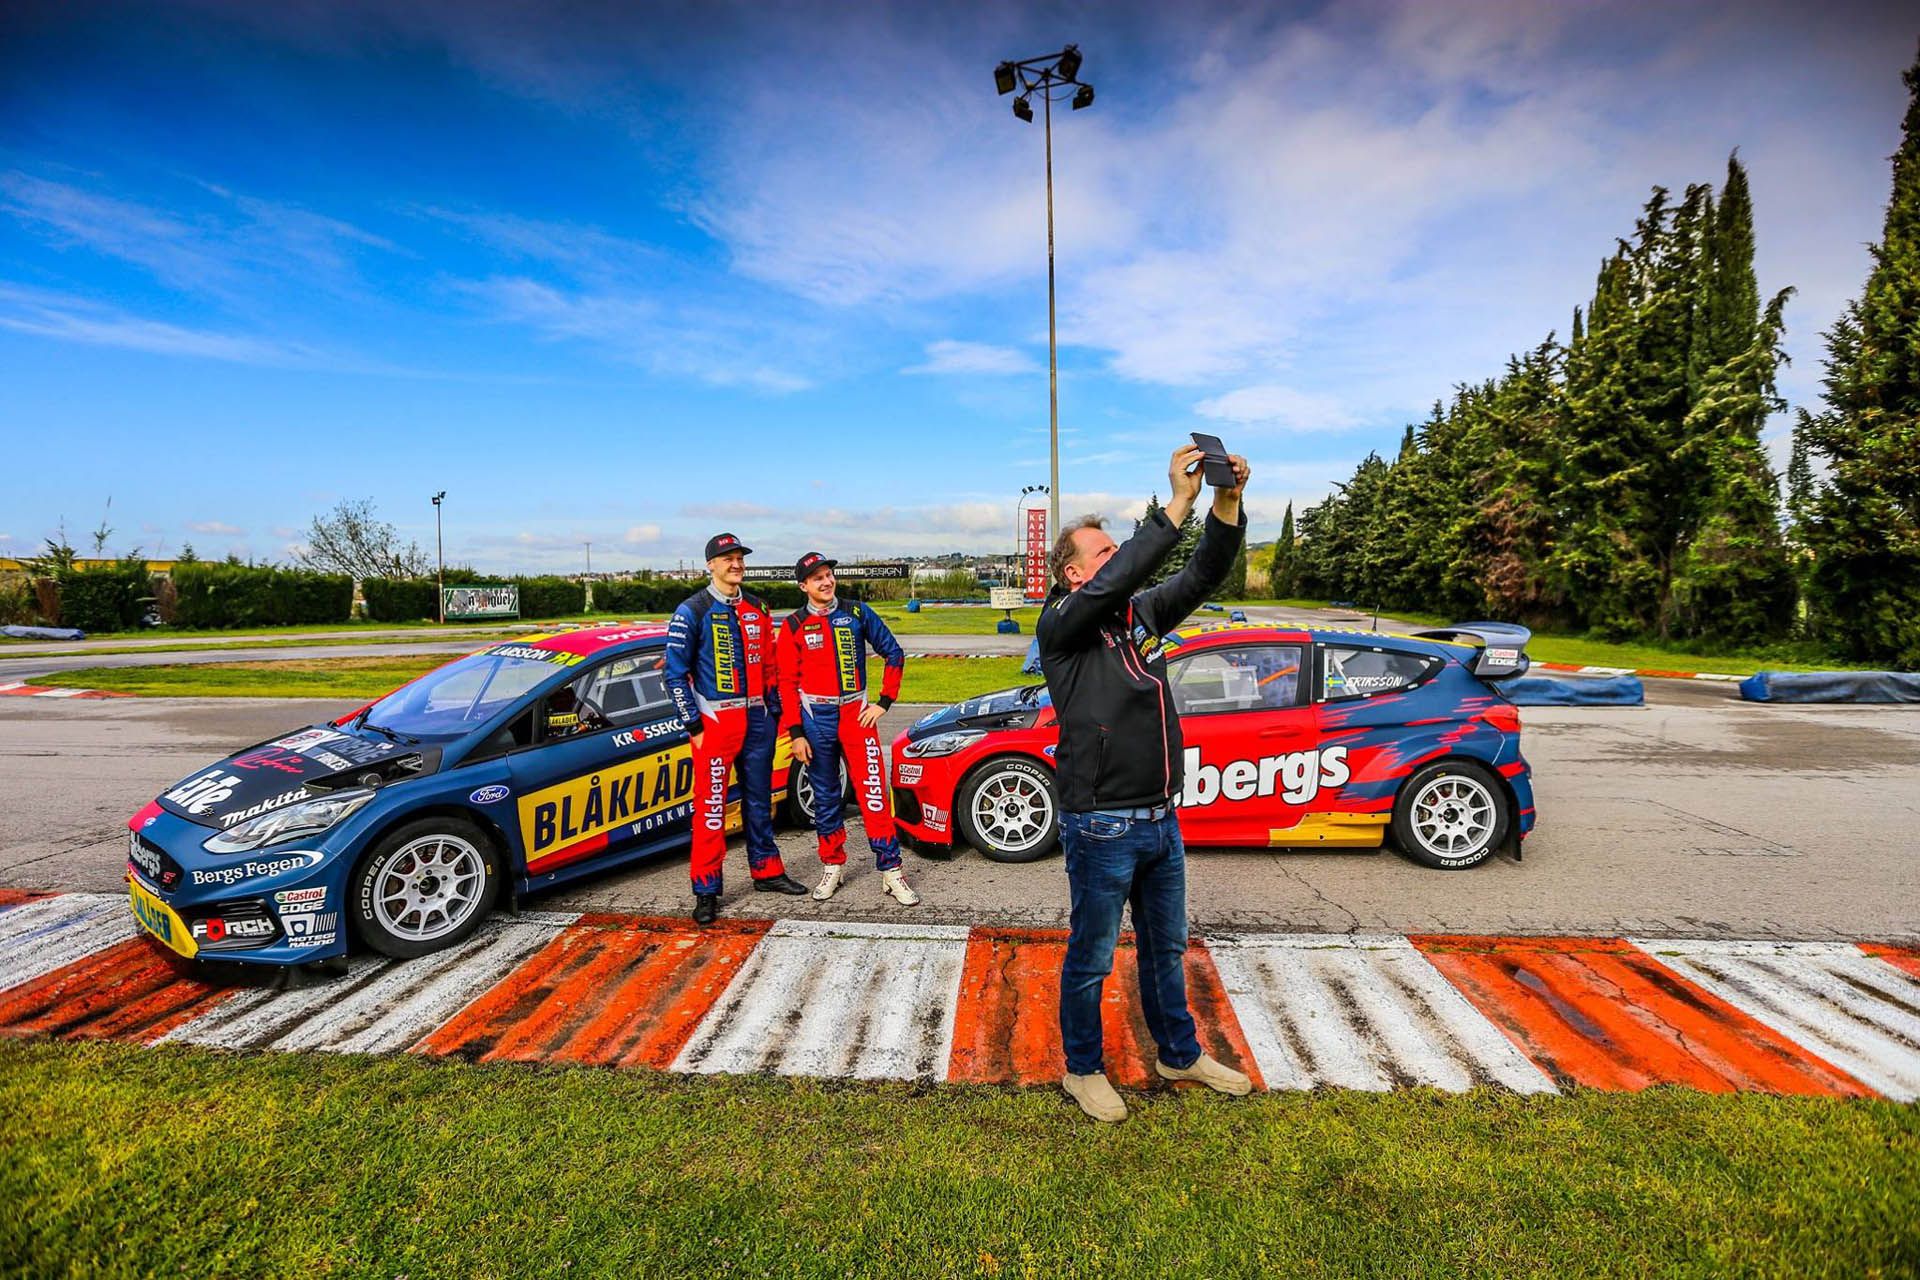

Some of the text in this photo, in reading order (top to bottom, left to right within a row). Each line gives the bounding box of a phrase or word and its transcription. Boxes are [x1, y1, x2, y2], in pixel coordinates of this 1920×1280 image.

[1346, 676, 1403, 687] ERIKSSON
[862, 737, 884, 812] Olsbergs
[1006, 763, 1051, 786] COOPER
[1174, 746, 1350, 807] bergs
[220, 787, 312, 828] makita
[704, 757, 725, 830] Olsbergs
[192, 856, 304, 885] Bergs Fegen
[1441, 847, 1489, 867] COOPER
[287, 888, 323, 901] Castrol
[361, 855, 385, 920] COOPER
[279, 900, 325, 914] EDGE
